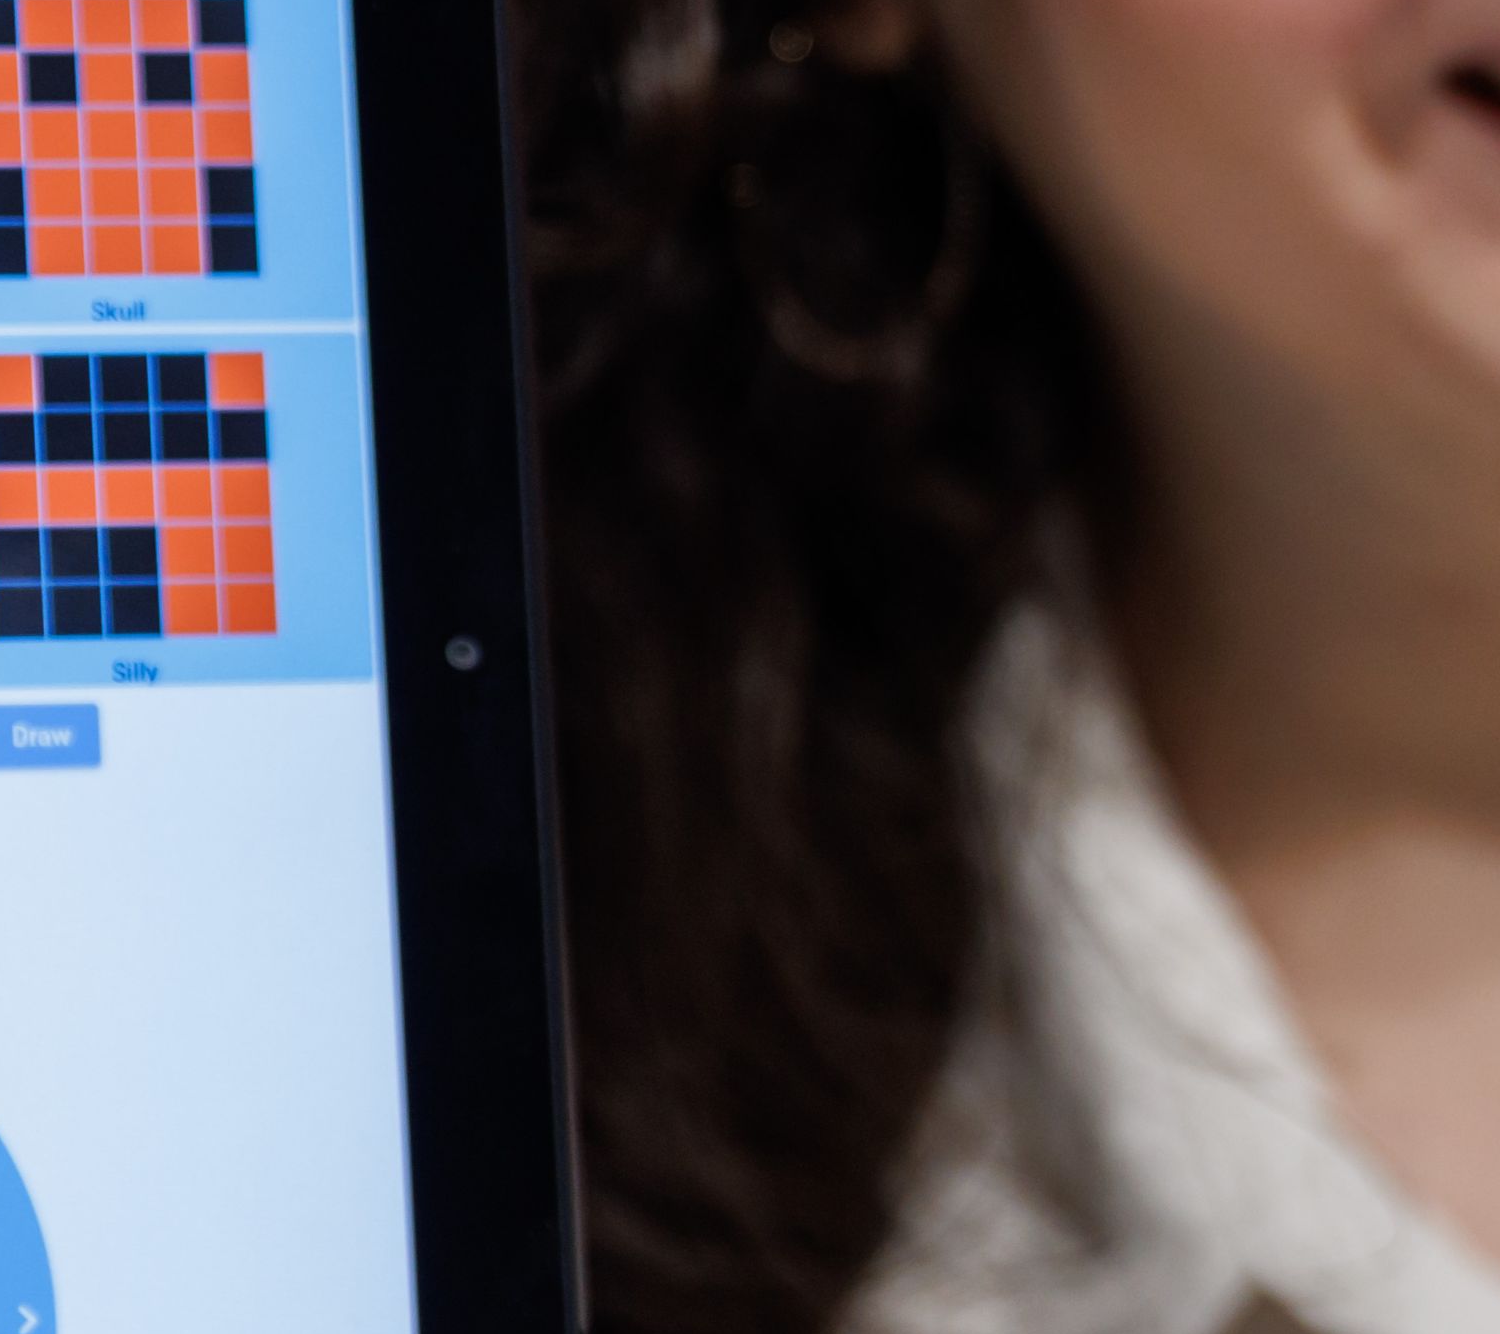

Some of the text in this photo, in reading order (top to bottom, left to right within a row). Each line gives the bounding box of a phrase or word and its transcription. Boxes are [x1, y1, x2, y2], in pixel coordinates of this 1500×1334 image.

[90, 299, 146, 323] Skull
[112, 660, 158, 685] Silly
[12, 724, 73, 748] Draw
